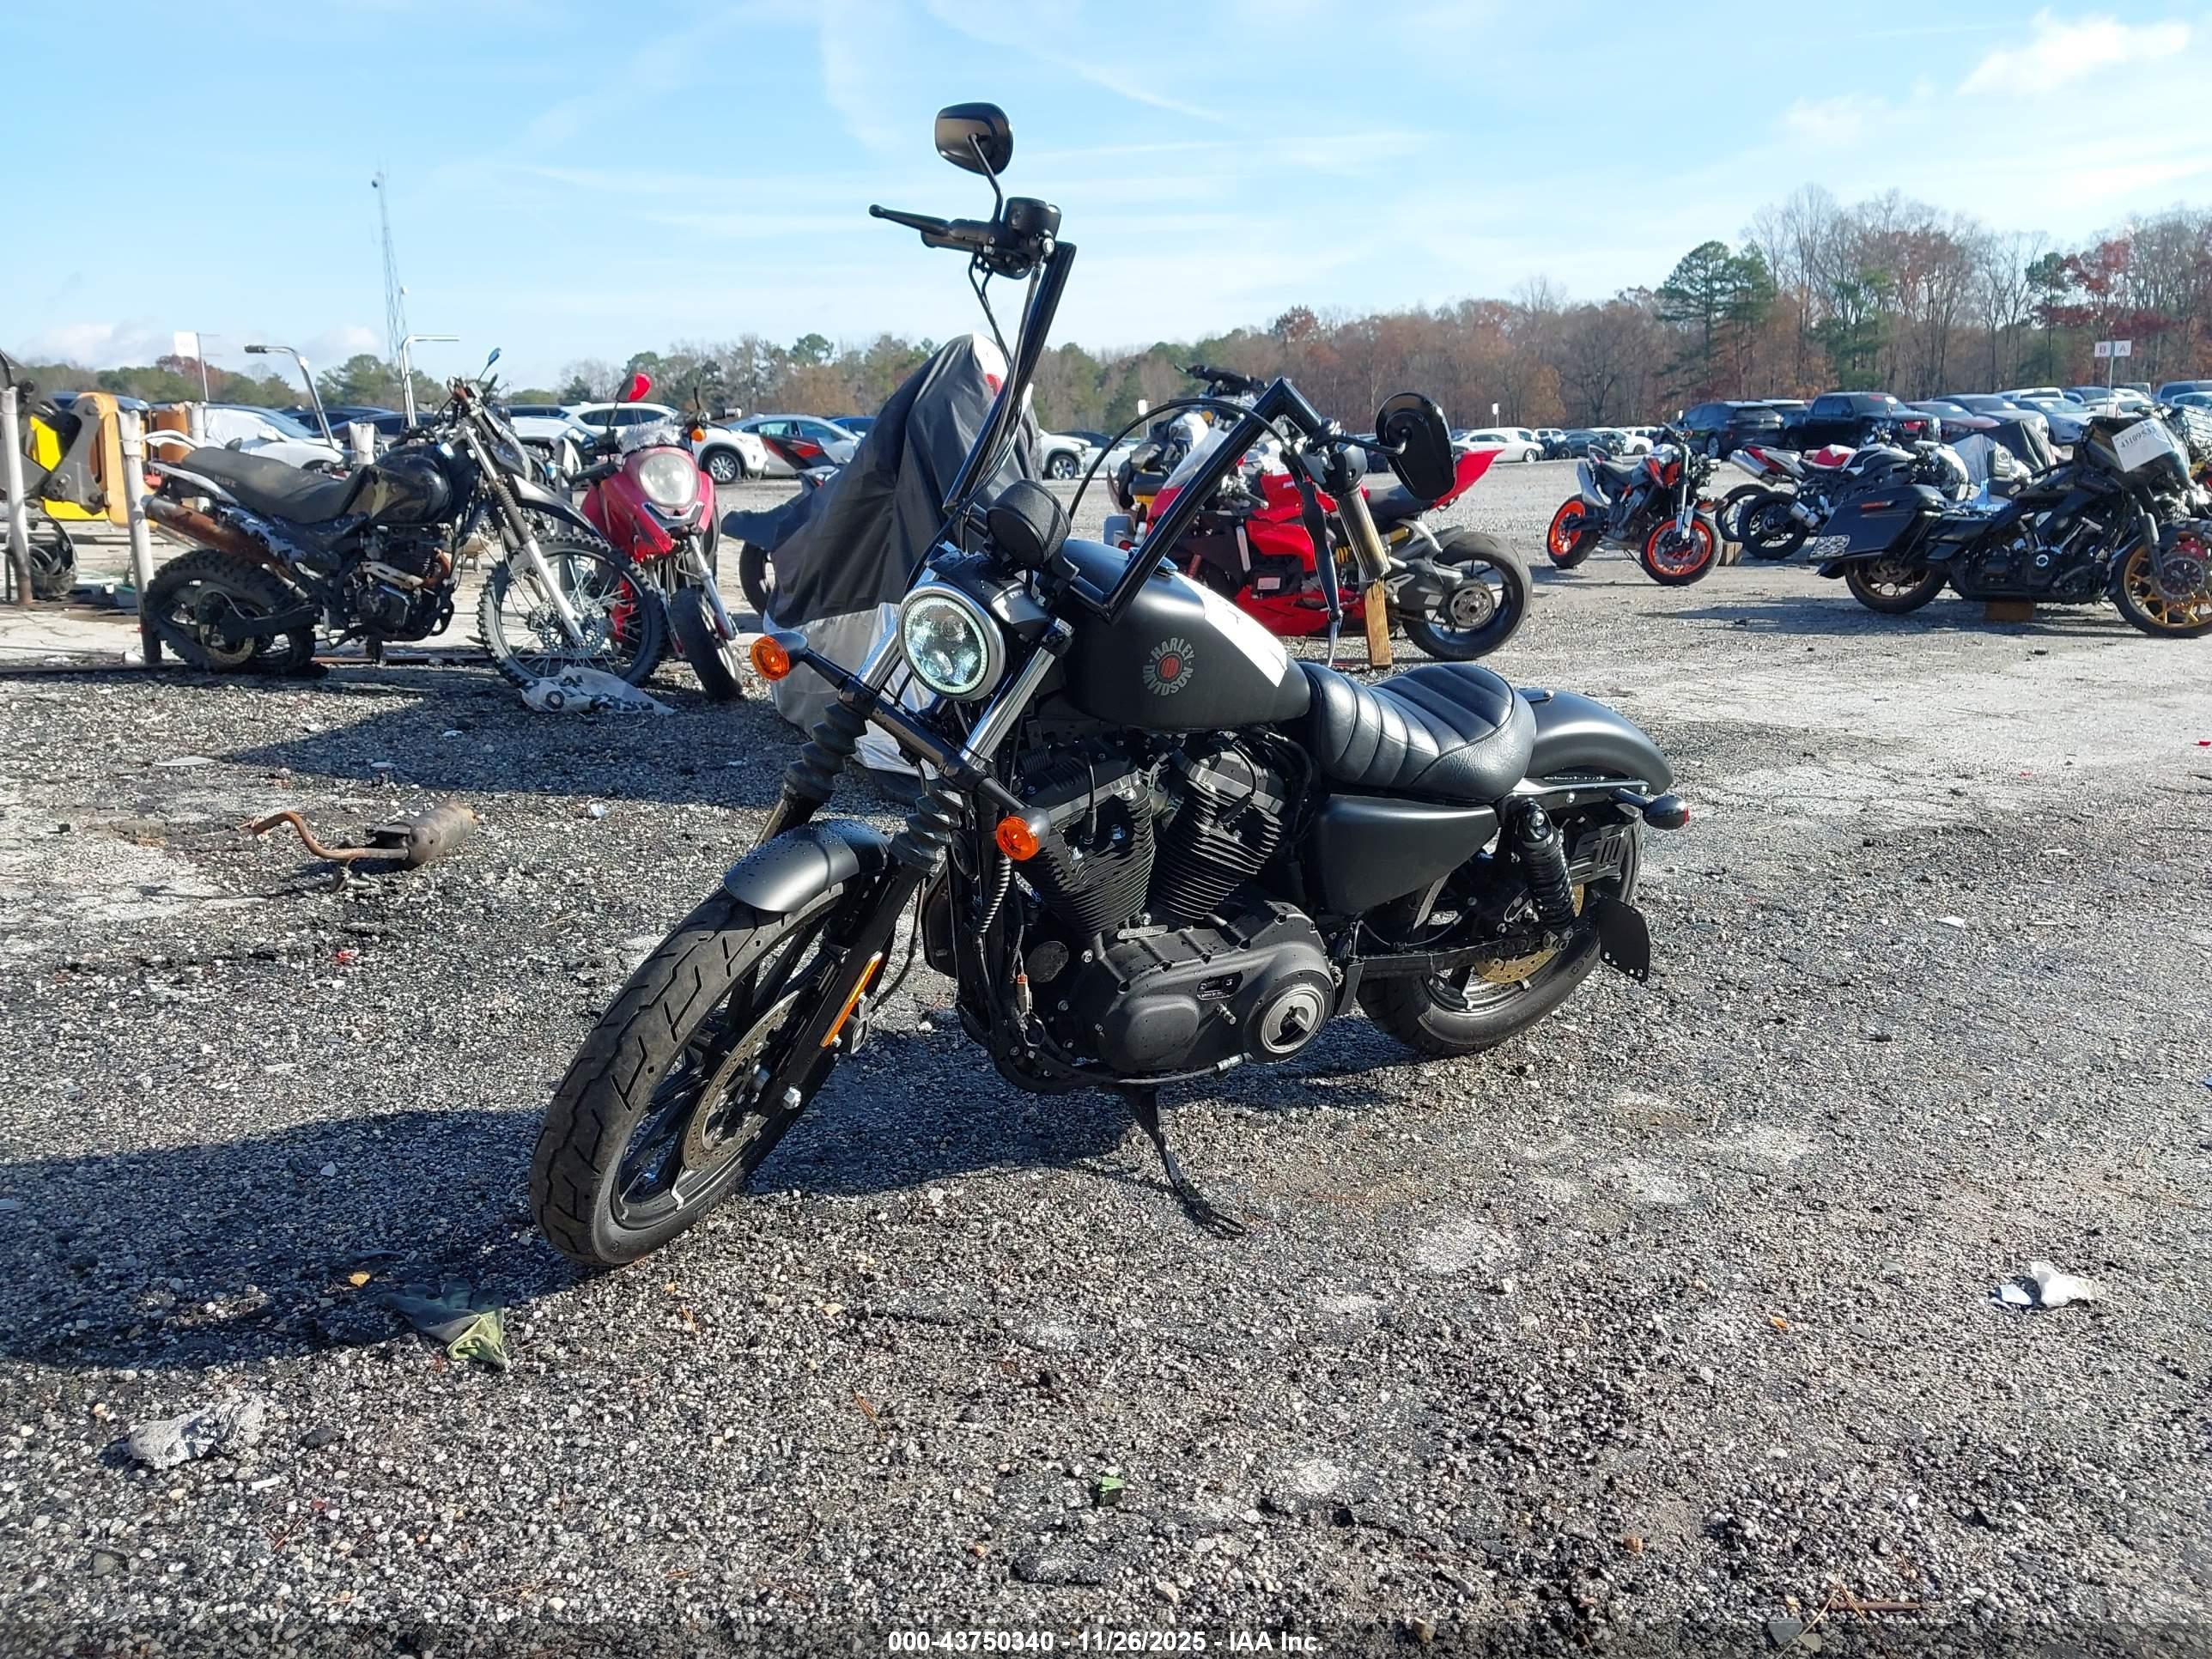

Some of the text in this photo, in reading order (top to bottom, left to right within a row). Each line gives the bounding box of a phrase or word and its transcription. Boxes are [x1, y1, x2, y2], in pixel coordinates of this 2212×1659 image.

[2118, 344, 2127, 353] A
[1151, 637, 1195, 661] HARLEY
[1142, 665, 1194, 696] DAVIDSON
